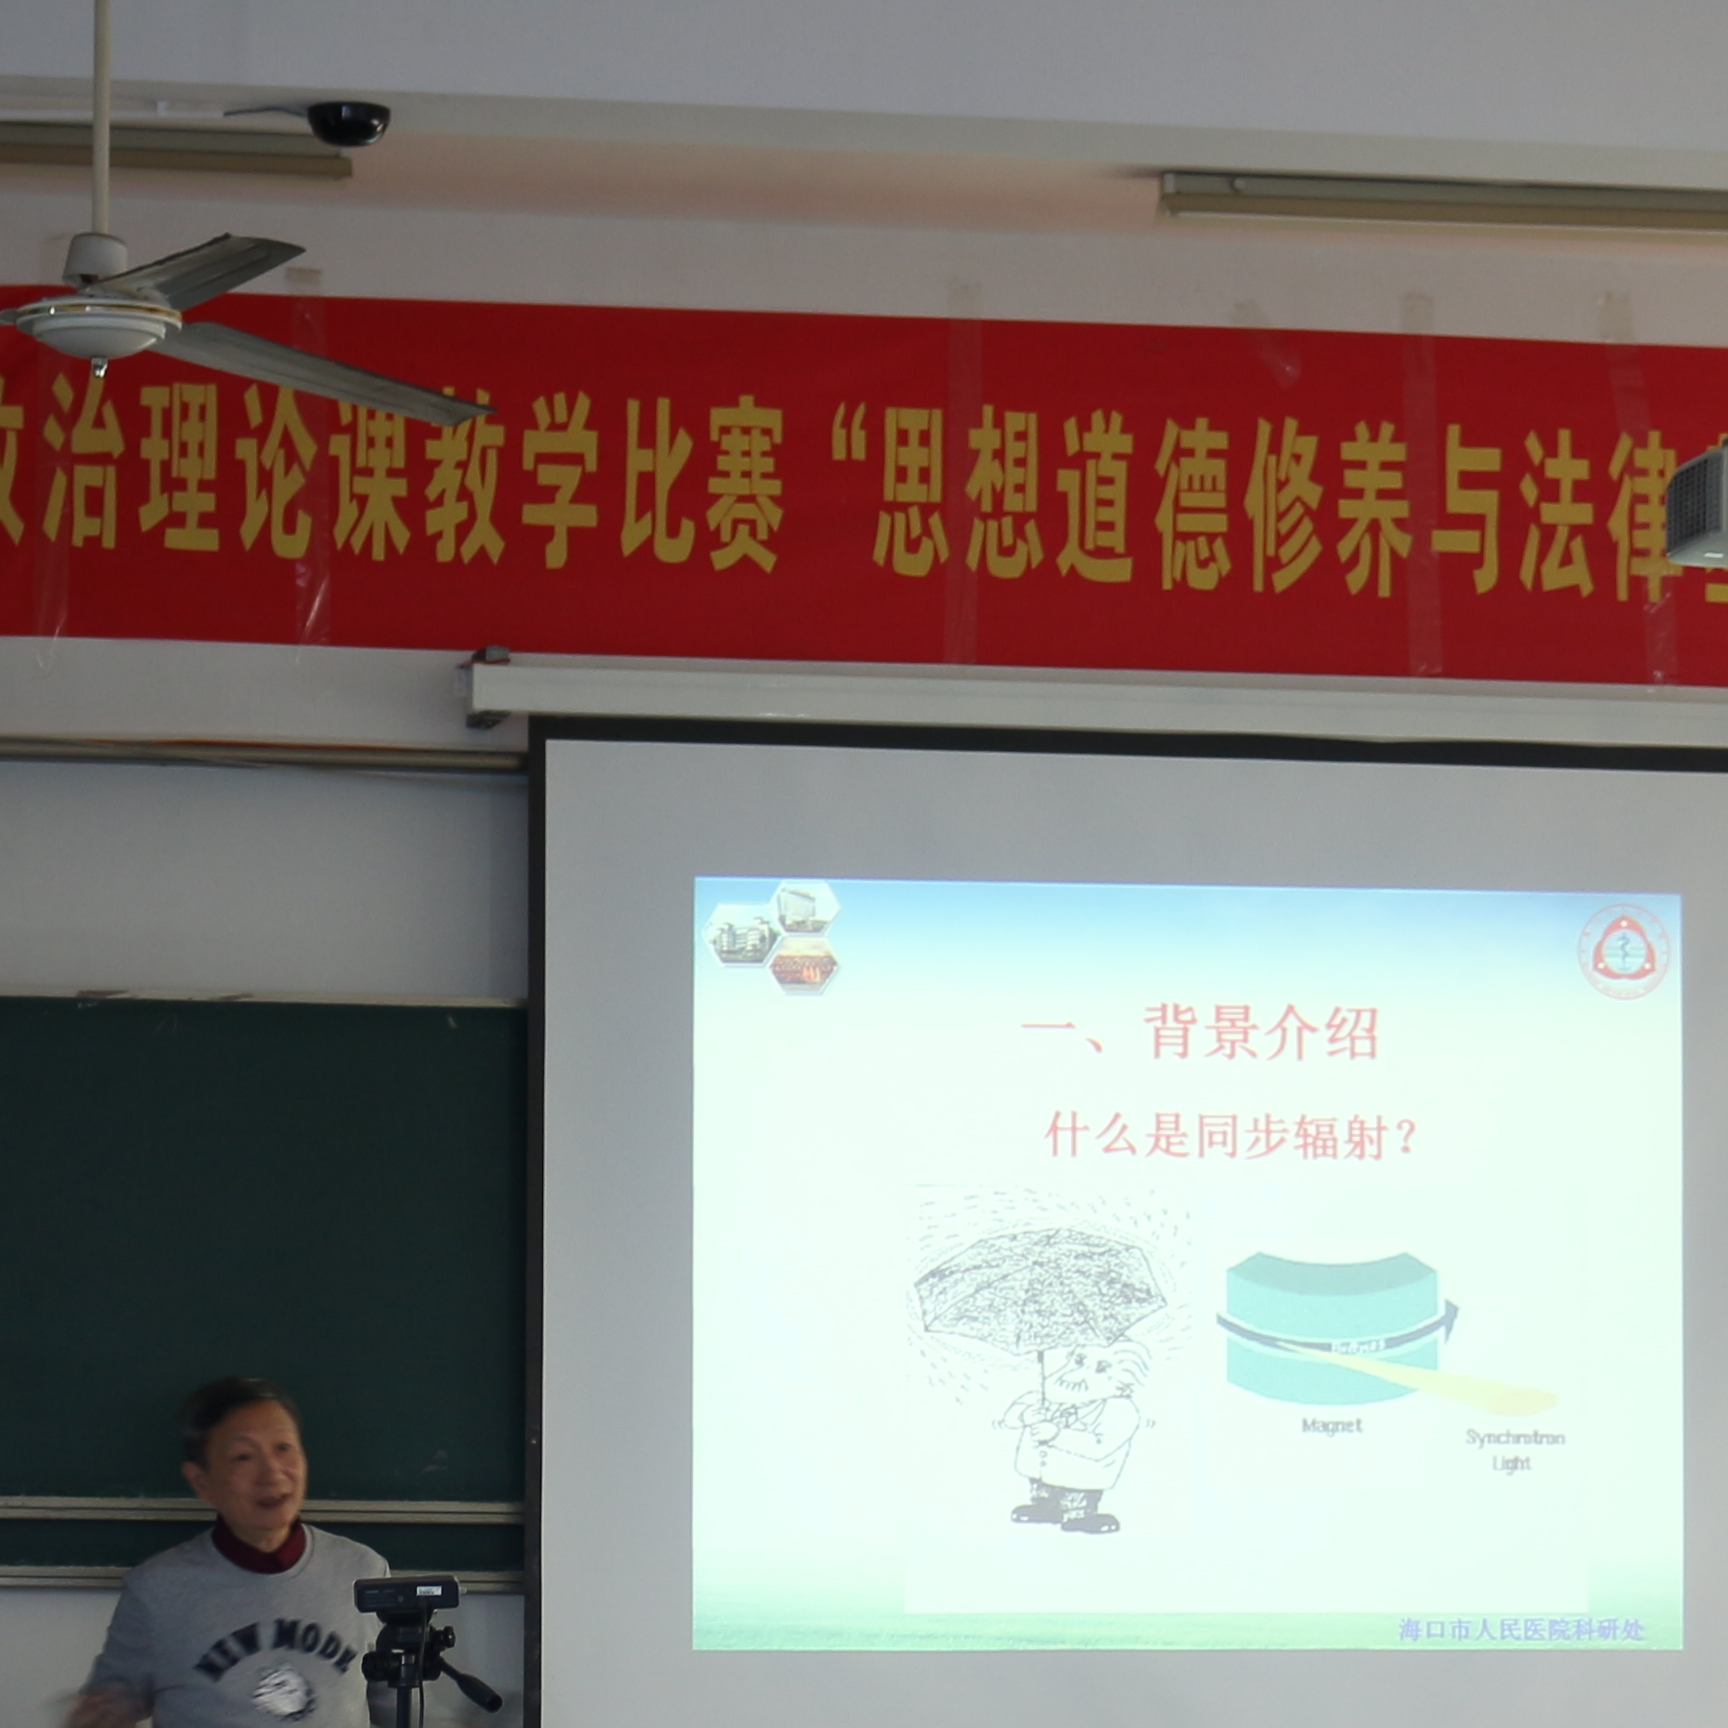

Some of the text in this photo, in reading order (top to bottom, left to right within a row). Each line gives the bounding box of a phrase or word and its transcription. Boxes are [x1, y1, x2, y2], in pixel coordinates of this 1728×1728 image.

[1020, 1002, 1380, 1061] 一、背景介绍
[1044, 1110, 1417, 1161] 什么是同步辐射？
[1302, 1418, 1363, 1437] Magnet
[1492, 1456, 1533, 1475] Light
[1398, 1617, 1645, 1642] 海口市人民医院科研处
[192, 1622, 262, 1683] NEW
